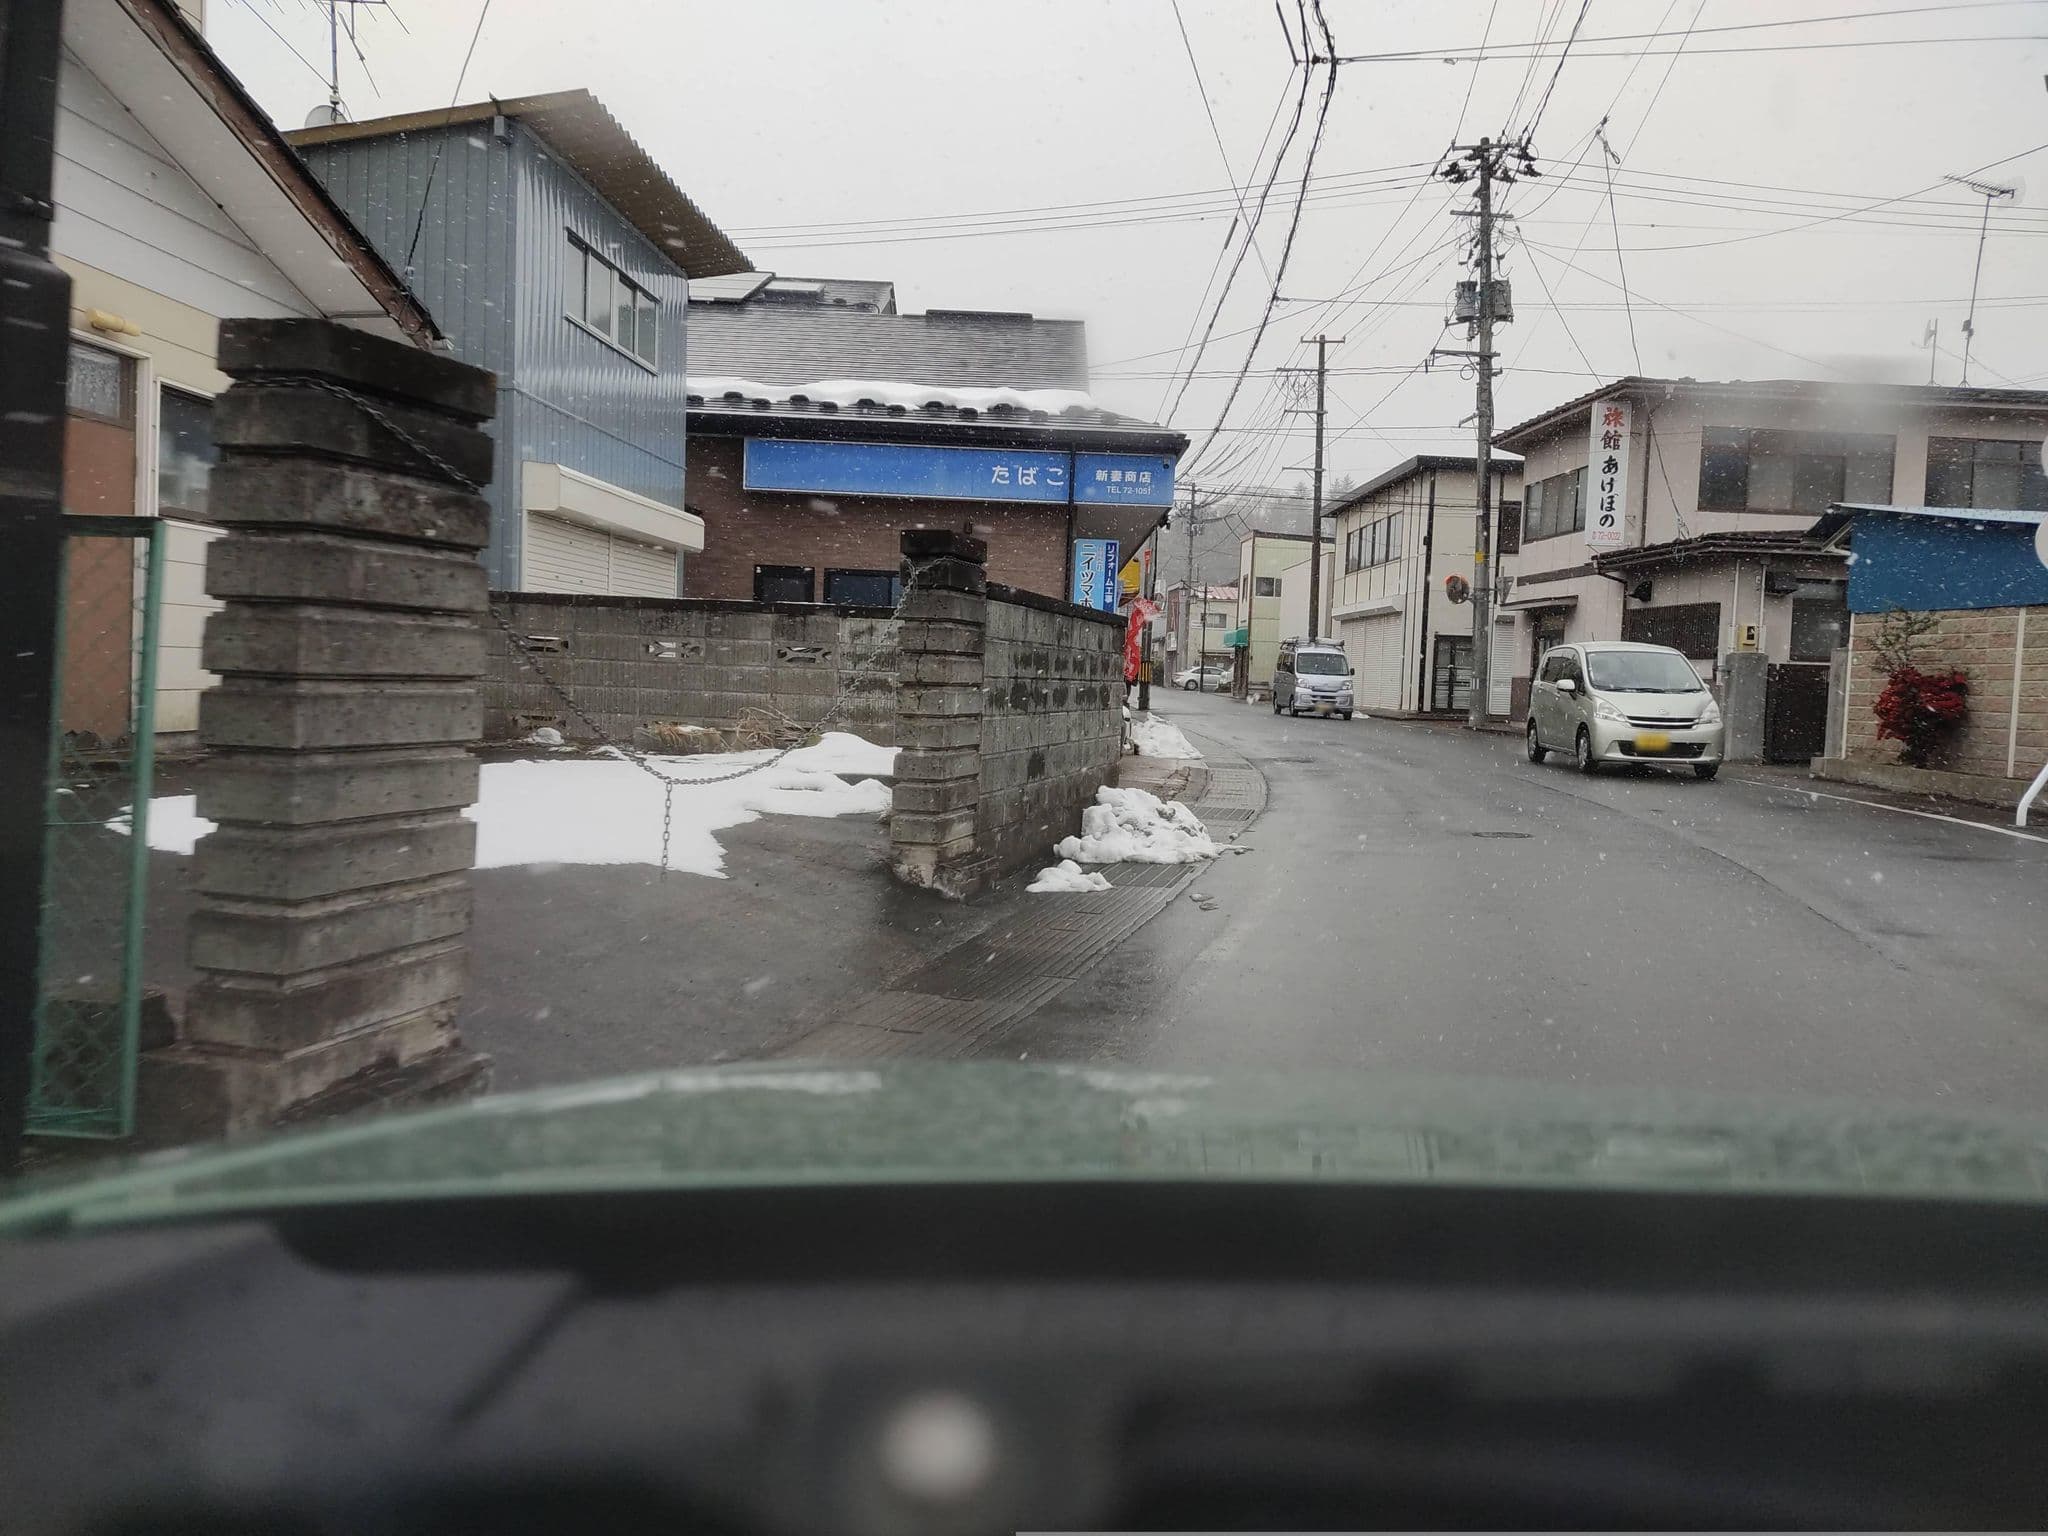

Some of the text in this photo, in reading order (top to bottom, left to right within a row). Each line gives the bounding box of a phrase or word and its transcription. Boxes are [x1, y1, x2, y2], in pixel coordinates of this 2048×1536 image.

[992, 465, 1065, 486] たばこ
[1106, 485, 1121, 495] TEL
